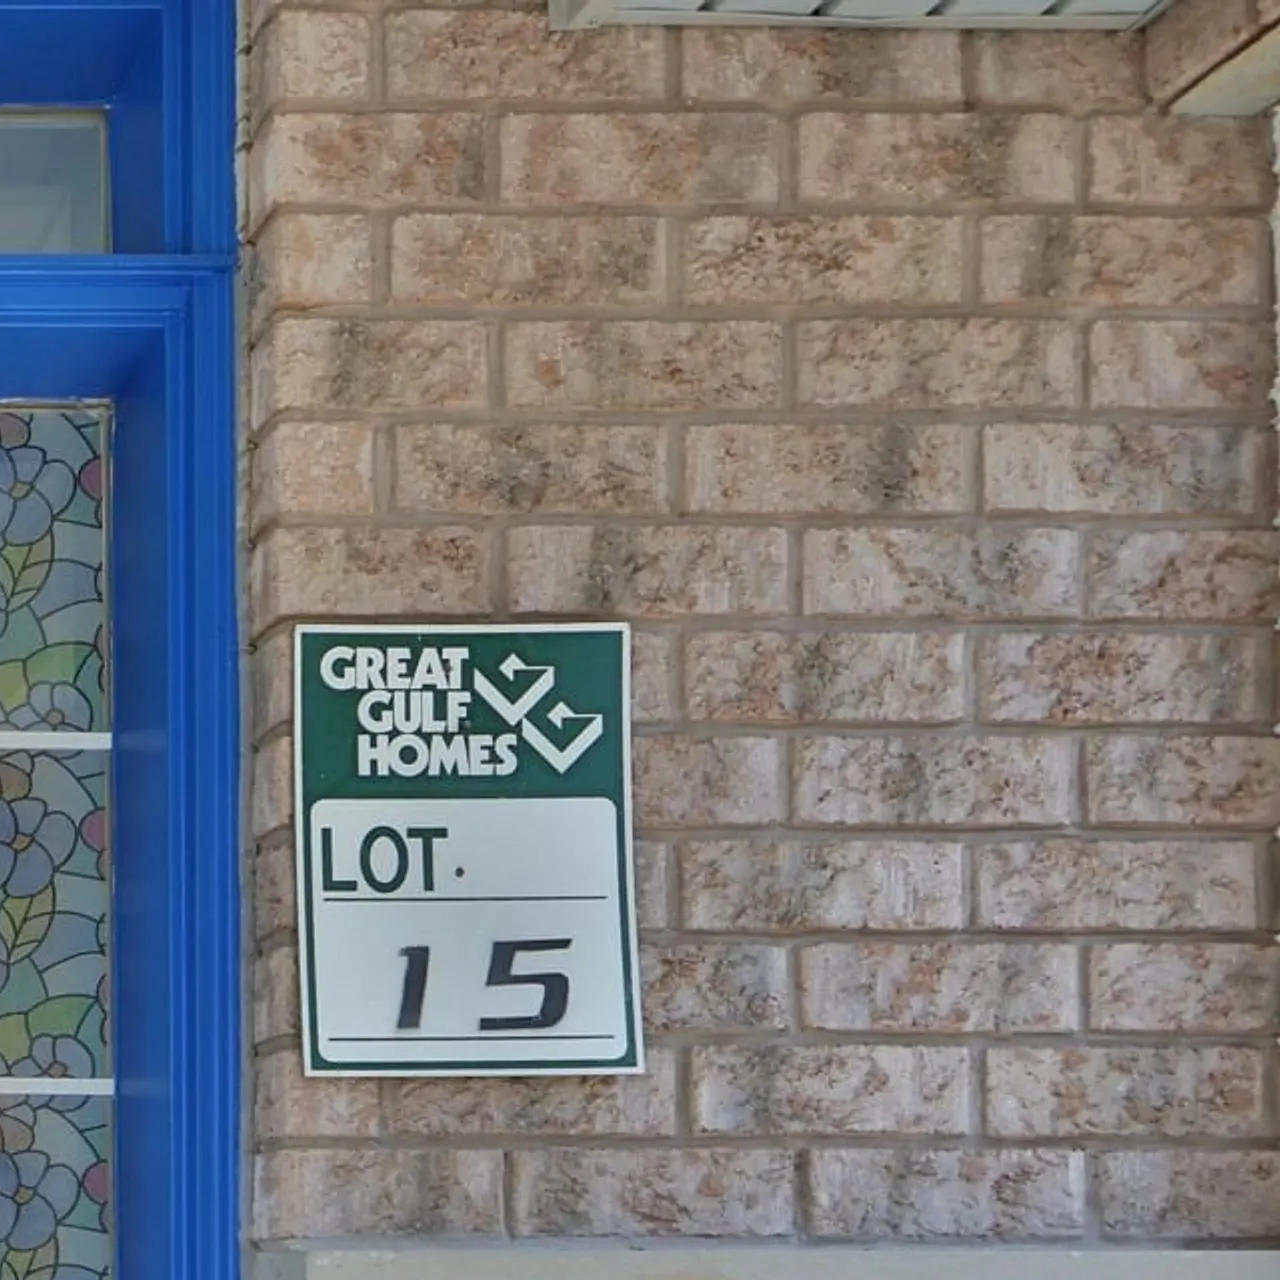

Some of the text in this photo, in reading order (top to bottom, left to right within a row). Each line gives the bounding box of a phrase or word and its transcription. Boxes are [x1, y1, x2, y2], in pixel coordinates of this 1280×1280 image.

[320, 646, 469, 690] GREAT
[357, 691, 471, 733] GULF
[357, 733, 518, 777] HOMES
[396, 938, 573, 1031] 15
